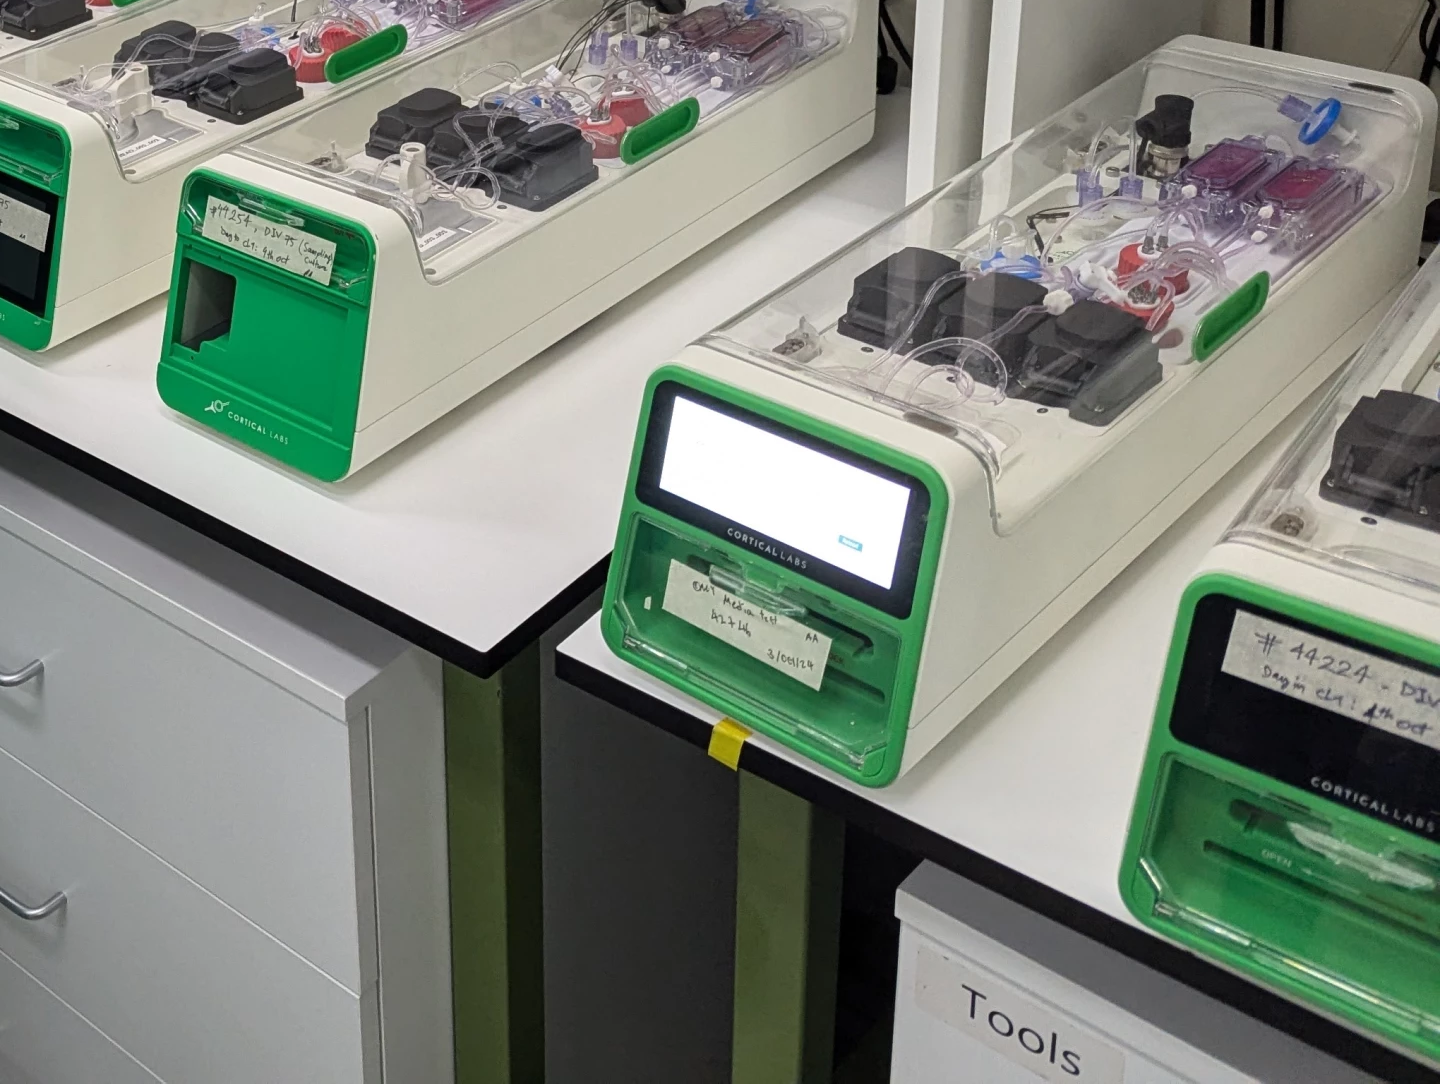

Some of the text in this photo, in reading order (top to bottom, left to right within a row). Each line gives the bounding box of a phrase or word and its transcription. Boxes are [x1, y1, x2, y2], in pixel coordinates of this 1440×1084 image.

[227, 411, 289, 445] CORTICAL LABS
[727, 527, 808, 570] CORTICAL LABS
[1254, 632, 1282, 656] #
[1291, 643, 1370, 684] 44224
[1311, 776, 1436, 834] CORTICAL LABS
[1261, 848, 1292, 868] OPEN
[961, 983, 1081, 1077] Tools
